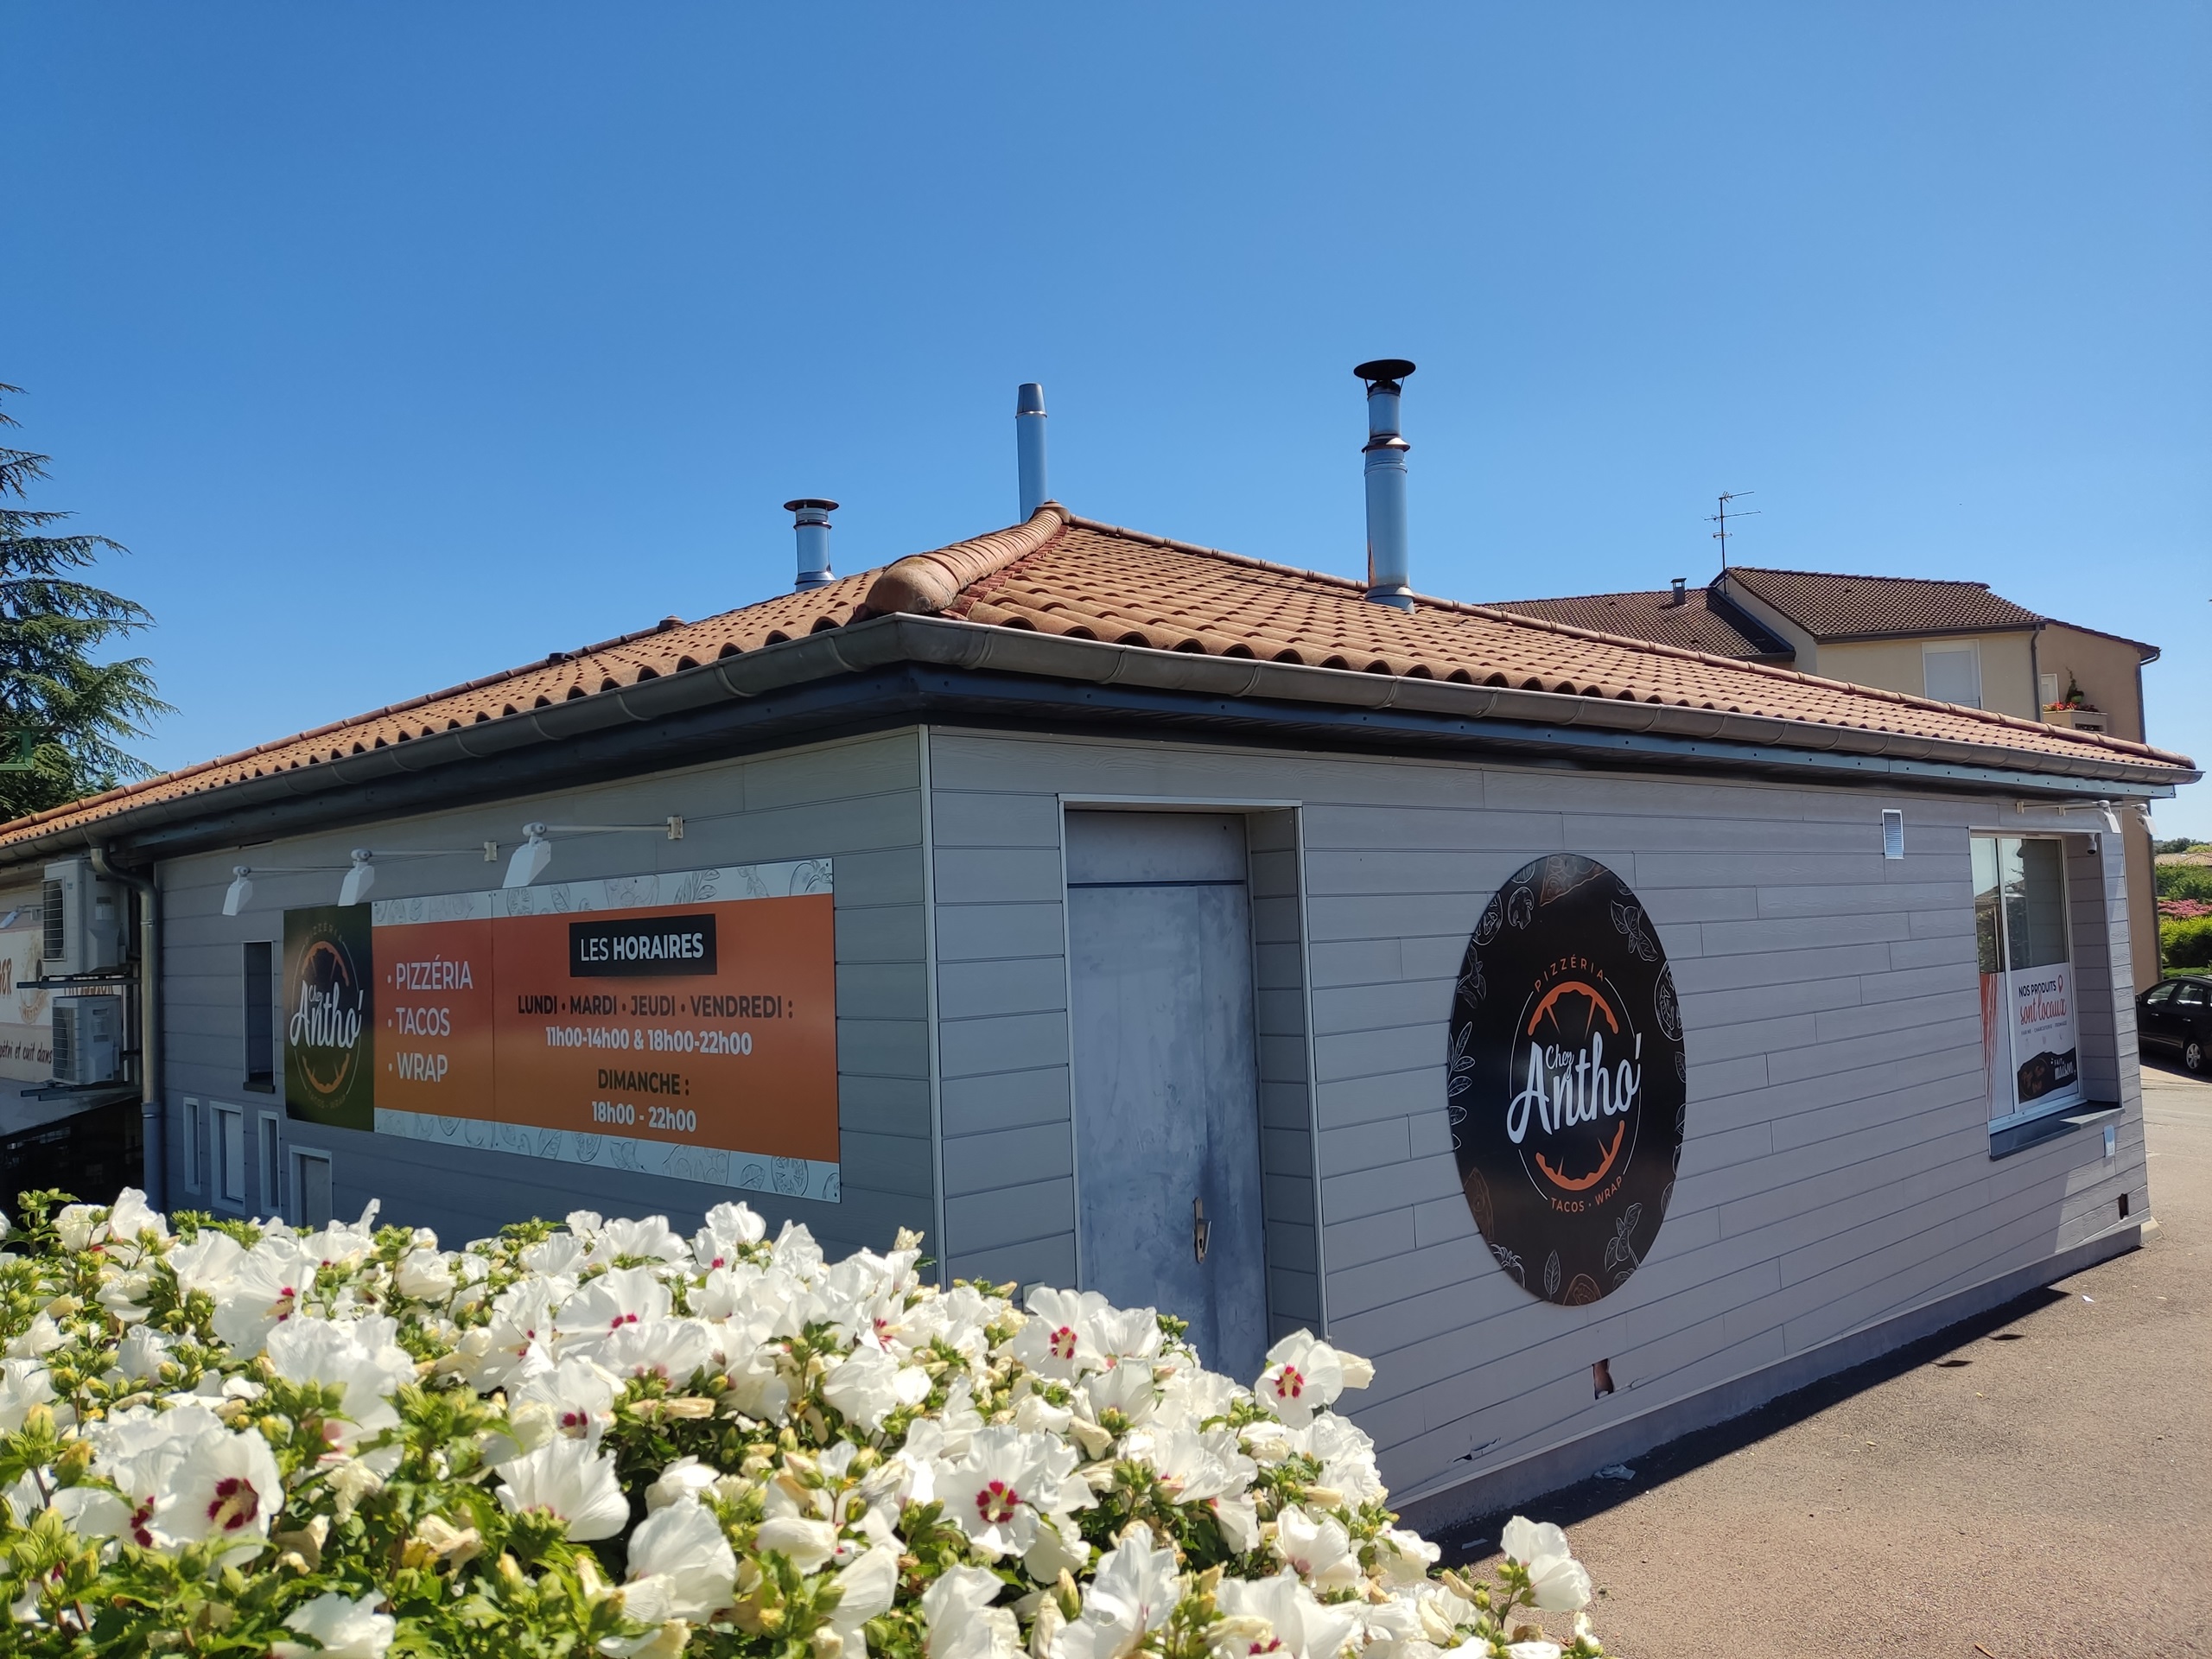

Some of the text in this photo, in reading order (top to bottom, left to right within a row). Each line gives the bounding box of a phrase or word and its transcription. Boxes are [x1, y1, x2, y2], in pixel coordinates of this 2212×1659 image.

[580, 932, 704, 962] LES HORAIRES
[396, 954, 474, 990] PIZZÉRIA
[1535, 953, 1606, 993] PIZZÉRIA
[2018, 980, 2056, 998] NOS PRODUITS
[518, 995, 557, 1014] LUNDI
[570, 995, 617, 1015] MARDI
[631, 995, 676, 1016] JEUDI
[690, 995, 782, 1018] VENDREDI
[2020, 990, 2067, 1026] sont locaux
[396, 1007, 451, 1037] TACOS
[15, 1041, 21, 1059] et
[22, 1042, 35, 1061] cuit
[36, 1042, 53, 1064] dans
[546, 1027, 753, 1055] 11h00-14h00 & 18h00-22h00
[397, 1052, 448, 1082] WRAP
[1545, 1044, 1574, 1078] Chez
[598, 1069, 680, 1096] DIMANCHE
[592, 1101, 635, 1126] 18h00
[648, 1103, 697, 1133] 22h00
[1551, 1174, 1624, 1212] TACOS WRAP
